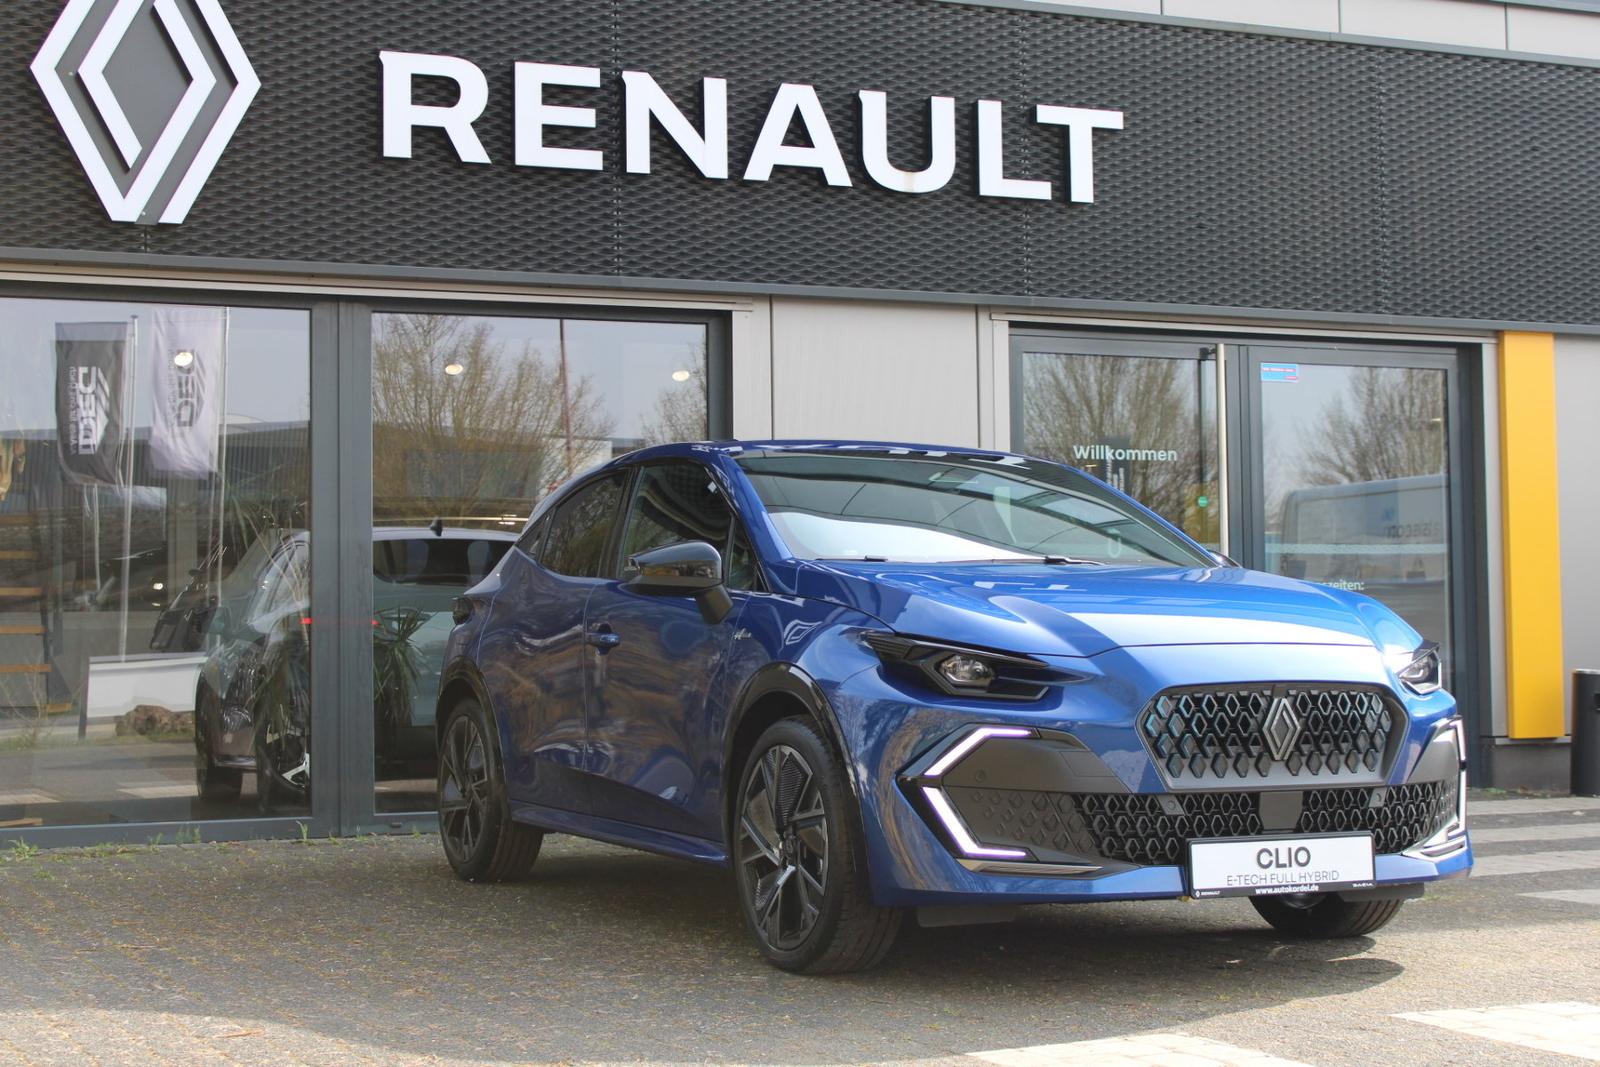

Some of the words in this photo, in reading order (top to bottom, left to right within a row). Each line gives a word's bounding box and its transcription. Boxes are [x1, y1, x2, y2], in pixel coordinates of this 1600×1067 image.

[379, 50, 1124, 204] RENAULT
[1073, 445, 1178, 461] Willkommen
[1256, 846, 1311, 869] CLIO
[1226, 874, 1267, 886] E-TECH
[1270, 872, 1296, 883] FULL
[1299, 870, 1340, 882] HYBRID
